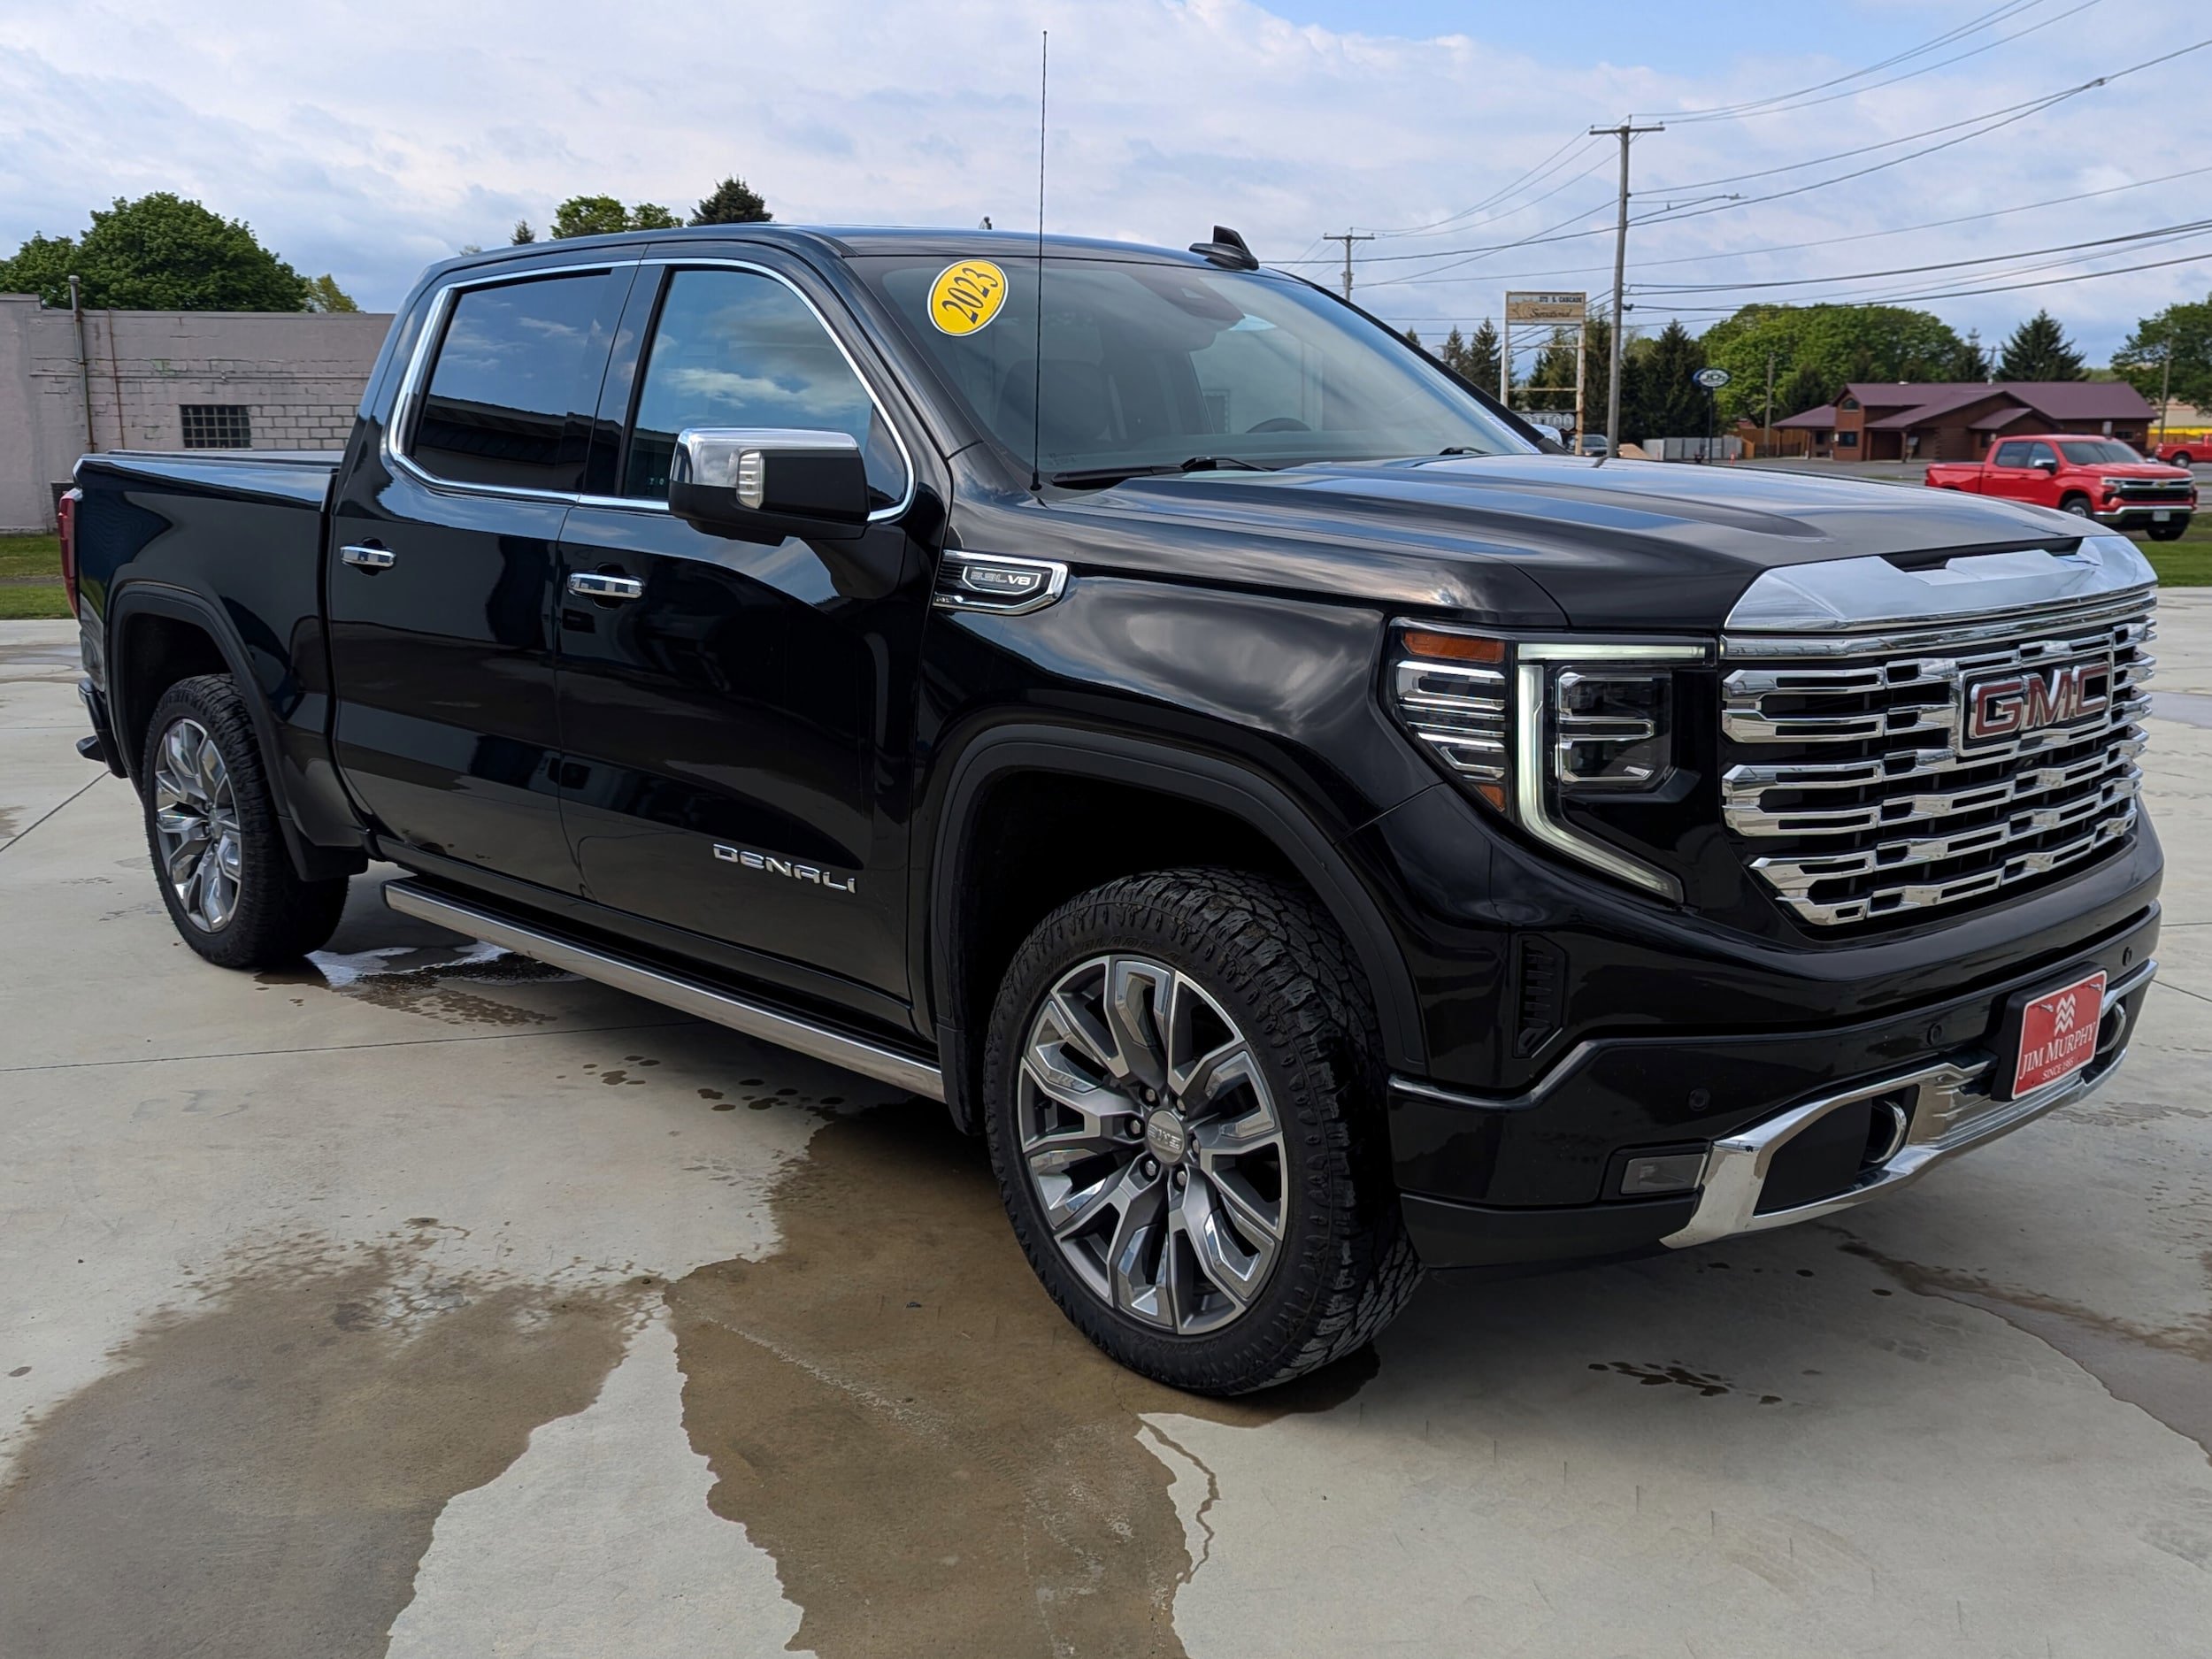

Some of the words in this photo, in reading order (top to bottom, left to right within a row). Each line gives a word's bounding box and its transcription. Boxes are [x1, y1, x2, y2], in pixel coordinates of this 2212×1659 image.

[941, 267, 999, 325] 2023
[1007, 574, 1032, 586] V8
[1968, 662, 2109, 739] GMC
[713, 843, 856, 895] DENALI
[2018, 1047, 2046, 1080] JIM
[2044, 1021, 2097, 1065] MURPHY
[2042, 1064, 2062, 1080] SINCE
